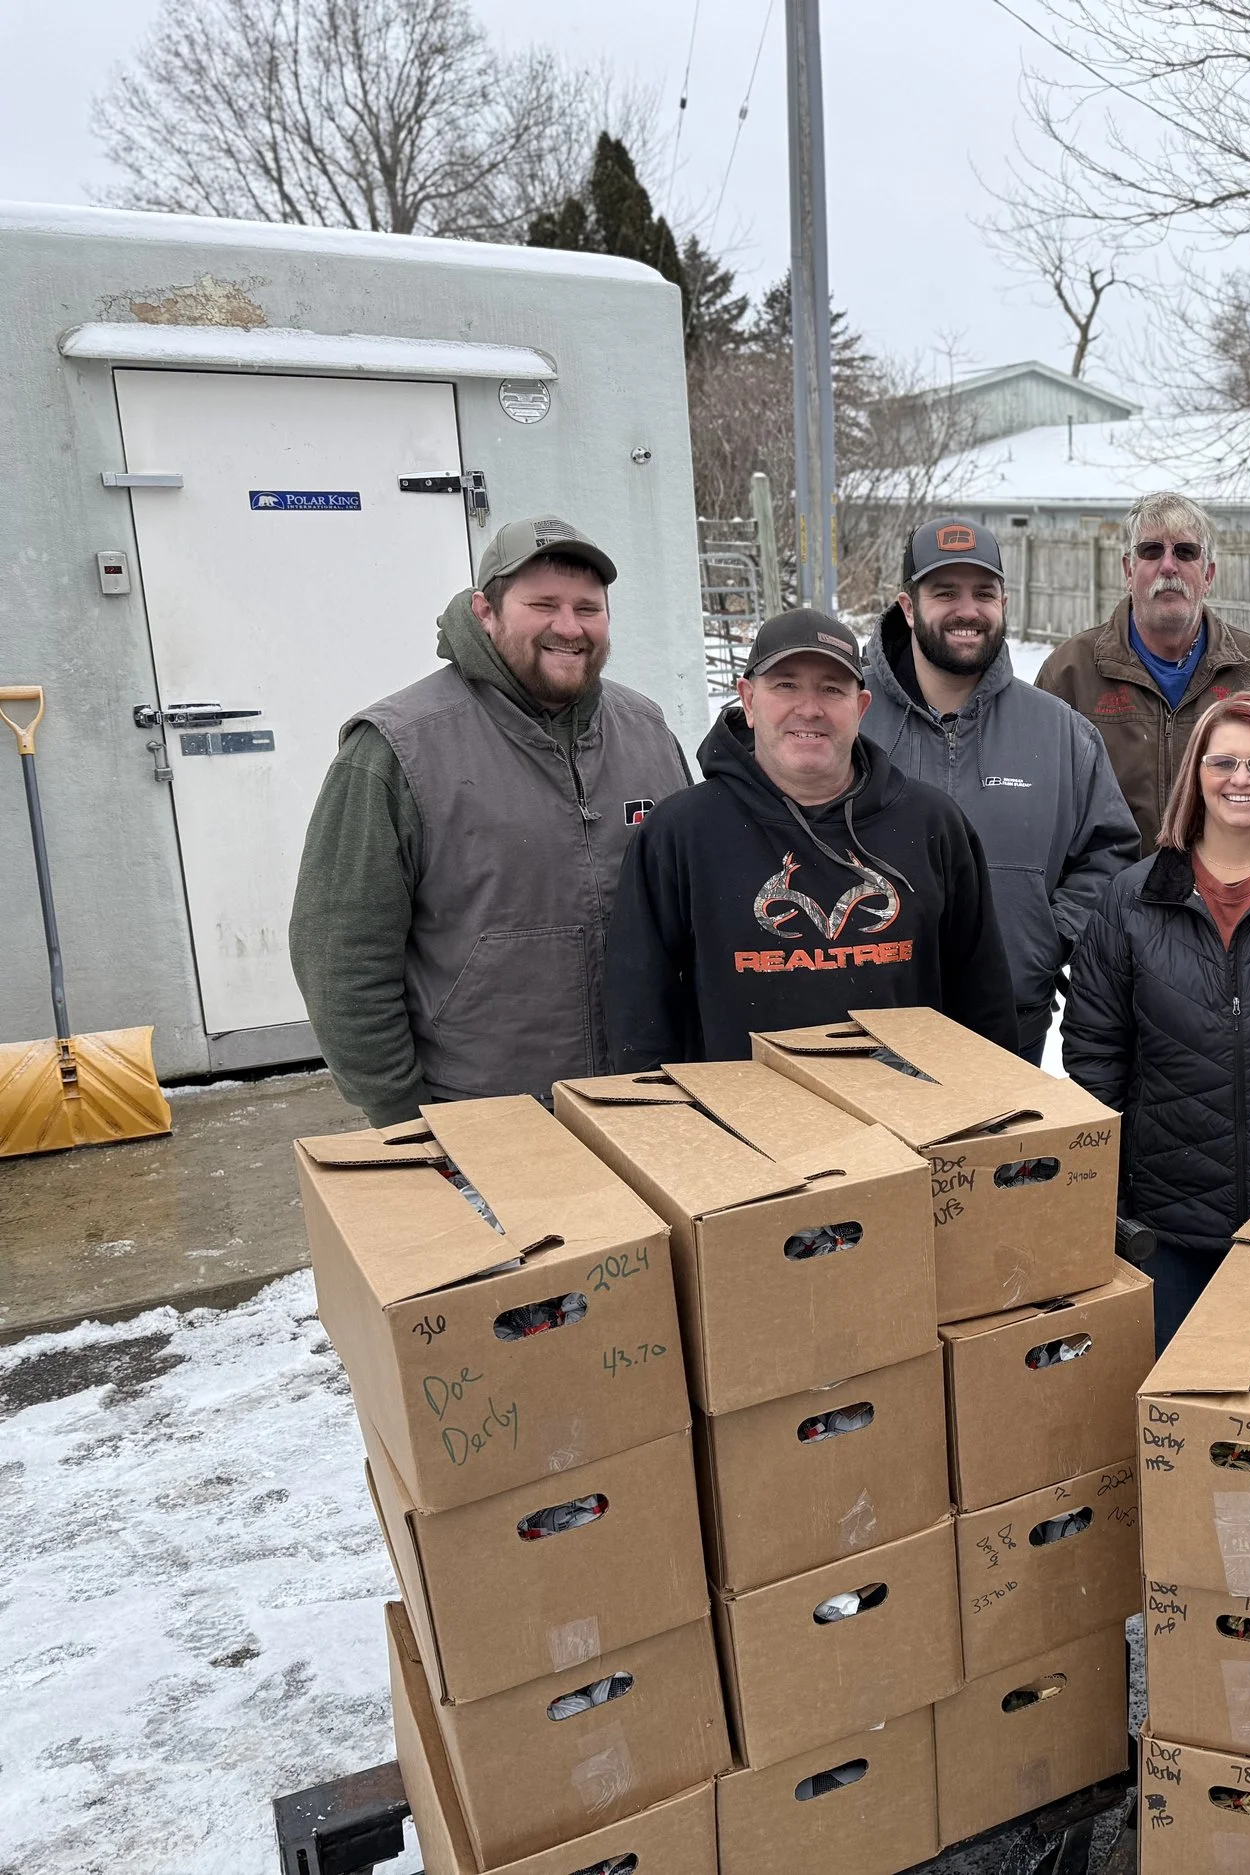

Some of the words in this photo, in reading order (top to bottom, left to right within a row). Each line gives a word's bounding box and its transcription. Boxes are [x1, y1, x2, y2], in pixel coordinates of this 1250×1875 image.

[286, 494, 326, 505] POLAR
[328, 494, 359, 506] KING
[734, 940, 913, 973] REALTREE
[1069, 1129, 1112, 1150] 2024
[930, 1155, 967, 1176] Doe
[931, 1169, 976, 1198] Derby
[586, 1247, 649, 1292] 2024
[412, 1314, 447, 1345] 36
[603, 1343, 667, 1378] 43.70
[423, 1367, 484, 1421] Doe
[1149, 1404, 1179, 1427] Doe
[442, 1397, 518, 1465] Derby
[1143, 1427, 1185, 1456] Derby
[1097, 1466, 1135, 1497] 2024
[997, 1523, 1017, 1550] Doe
[976, 1536, 999, 1570] Derby
[1150, 1581, 1178, 1596] Doe
[1149, 1595, 1188, 1622] Derby
[1151, 1740, 1181, 1766] Doe
[1146, 1757, 1181, 1786] Derby
